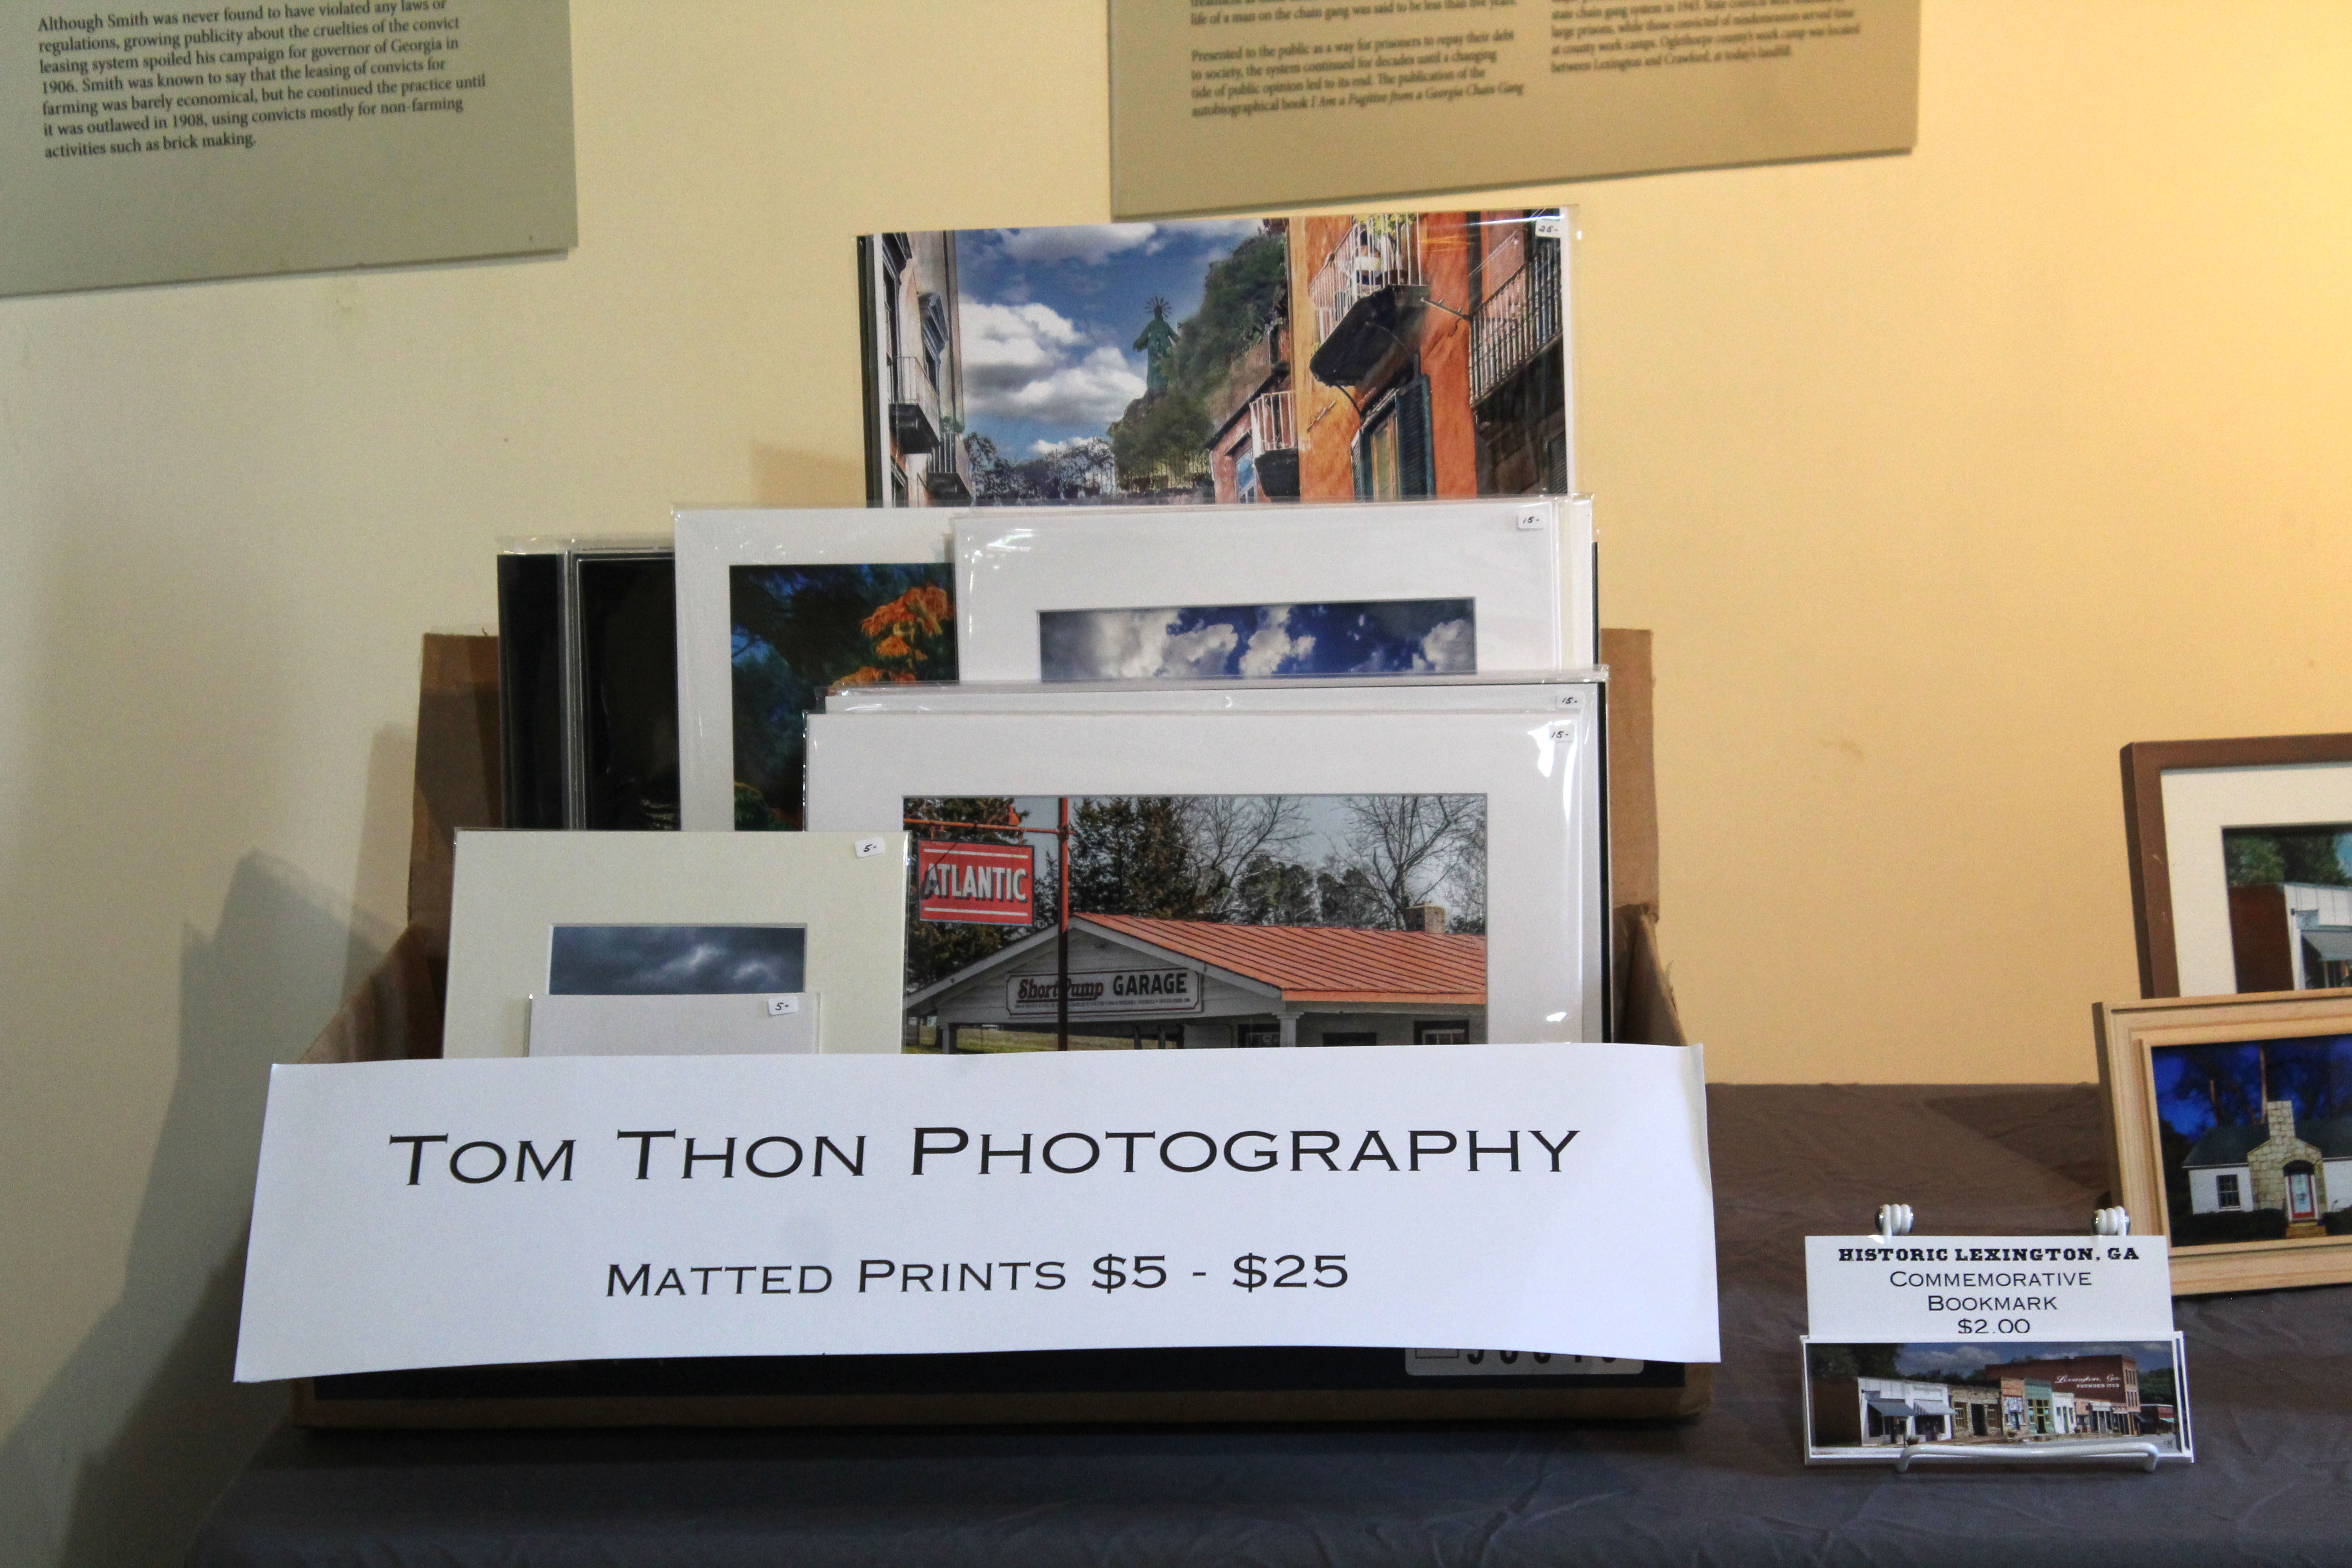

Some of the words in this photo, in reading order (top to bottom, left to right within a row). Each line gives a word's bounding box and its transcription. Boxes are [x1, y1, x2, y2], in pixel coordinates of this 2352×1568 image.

[37, 14, 103, 32] Although
[108, 11, 148, 27] Smith
[153, 15, 178, 25] was
[182, 12, 219, 23] never
[224, 5, 263, 21] found
[268, 5, 280, 19] to
[285, 4, 314, 18] have
[319, 0, 370, 16] violated
[375, 3, 396, 16] any
[402, 0, 428, 11] laws
[433, 0, 445, 10] or
[39, 36, 118, 55] regulations,
[124, 31, 179, 51] growing
[184, 29, 242, 48] publicity
[248, 25, 284, 40] about
[289, 24, 309, 38] the
[314, 21, 368, 37] cruelties
[372, 19, 384, 34] of
[389, 18, 408, 33] the
[413, 15, 459, 31] convict
[40, 59, 88, 74] leasing
[93, 54, 138, 74] system
[143, 50, 191, 70] spoiled
[196, 49, 215, 64] his
[220, 46, 284, 65] campaign
[289, 44, 306, 58] for
[312, 44, 370, 61] governor
[375, 39, 387, 53] of
[391, 38, 442, 54] Georgia
[446, 34, 459, 49] in
[43, 78, 78, 94] 1906.
[83, 75, 123, 91] Smith
[128, 78, 153, 88] was
[157, 73, 204, 87] known
[208, 69, 221, 83] to
[226, 73, 245, 86] say
[250, 66, 275, 81] that
[280, 64, 300, 79] the
[305, 64, 349, 79] leasing
[354, 60, 366, 75] of
[371, 57, 423, 74] convicts
[427, 56, 445, 70] for
[43, 100, 97, 116] farming
[103, 101, 127, 111] was
[132, 93, 172, 111] barely
[177, 88, 257, 107] economical,
[262, 87, 283, 101] but
[288, 85, 303, 100] he
[307, 81, 372, 98] continued
[377, 80, 396, 94] the
[402, 77, 451, 97] practice
[456, 74, 486, 89] until
[44, 122, 53, 136] it
[58, 125, 83, 135] was
[87, 115, 149, 133] outlawed
[154, 115, 167, 129] in
[174, 112, 206, 128] 1908,
[212, 110, 248, 127] using
[252, 106, 306, 122] convicts
[310, 103, 353, 121] mostly
[358, 102, 376, 116] for
[381, 98, 463, 113] non-farming
[45, 141, 106, 157] activities
[110, 137, 141, 153] such
[146, 142, 159, 151] as
[163, 134, 197, 150] brick
[202, 132, 255, 149] making.
[863, 844, 877, 852] 5-
[923, 863, 1027, 902] ATLANTIC
[1018, 979, 1059, 1000] Short
[1113, 973, 1187, 996] GARAGE
[775, 1002, 789, 1011] 5-
[389, 1133, 577, 1186] TOM
[617, 1129, 867, 1181] THON
[911, 1127, 1580, 1176] PHOTOGRAPHY
[1839, 1248, 1948, 1261] HISTORIC
[1955, 1248, 2101, 1262] LEXINGTON,
[2107, 1248, 2140, 1260] GA
[607, 1264, 833, 1297] MATTED
[858, 1259, 1067, 1294] PRINTS
[1092, 1254, 1167, 1294] $5
[1233, 1253, 1349, 1293] $25
[1890, 1271, 2092, 1288] COMMEMORATIVE
[1928, 1295, 2058, 1312] BOOKMARK
[1958, 1318, 2031, 1334] $2.00
